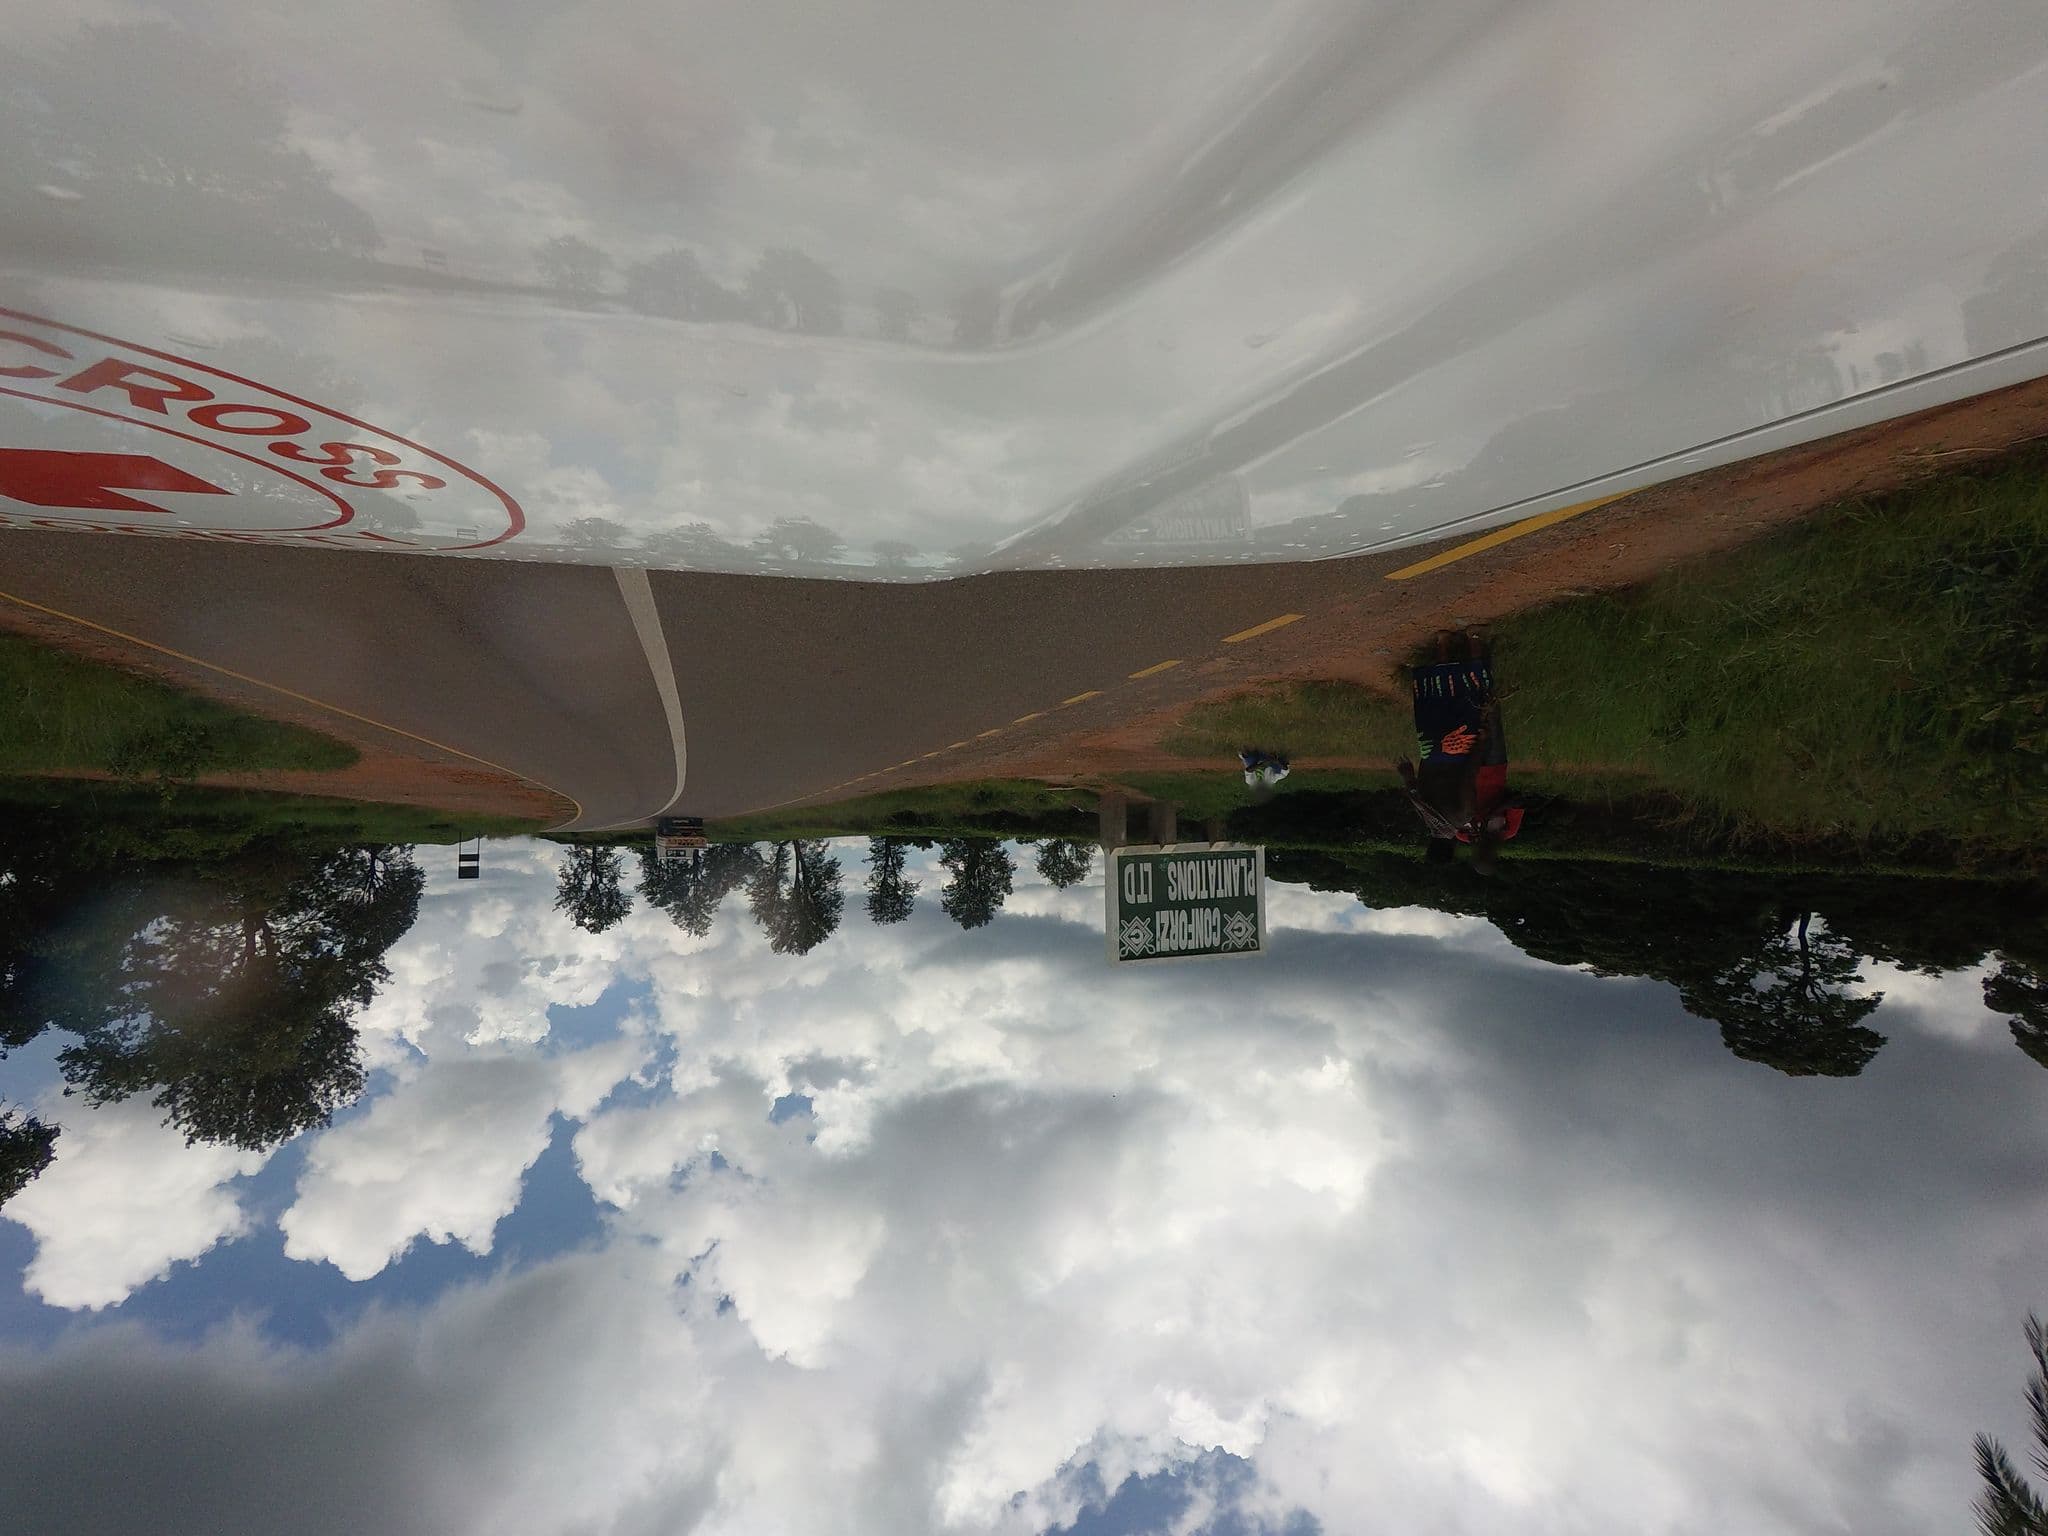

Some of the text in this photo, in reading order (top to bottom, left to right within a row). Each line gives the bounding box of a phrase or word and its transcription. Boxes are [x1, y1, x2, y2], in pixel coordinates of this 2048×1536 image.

[1124, 857, 1256, 904] PLANTATIONS LTD
[1155, 906, 1221, 953] CONFORZI
